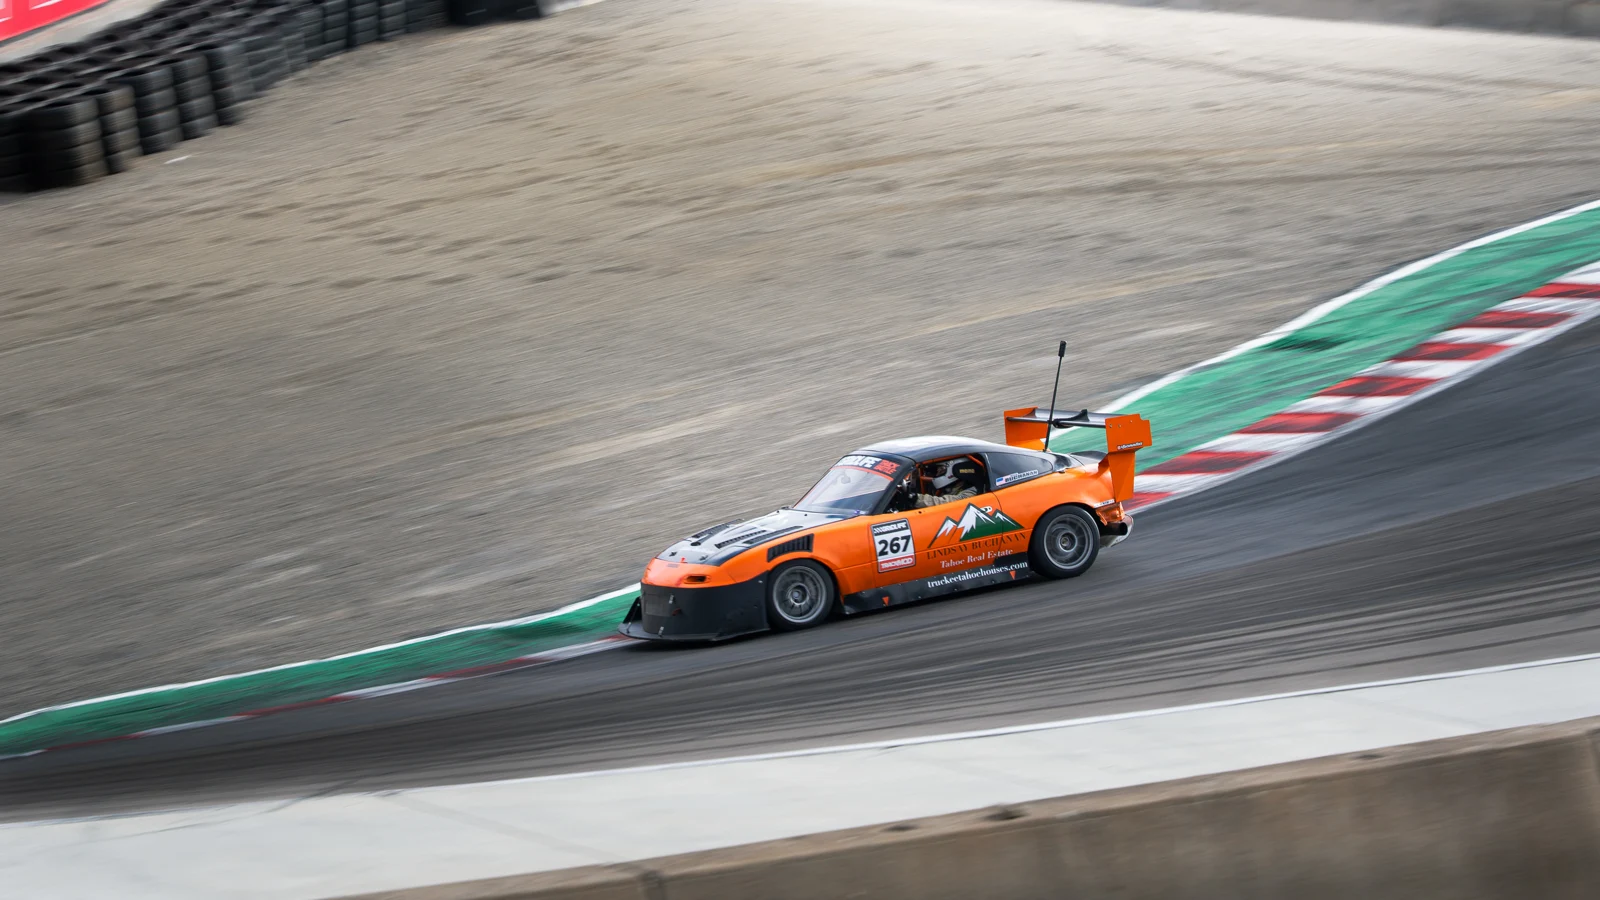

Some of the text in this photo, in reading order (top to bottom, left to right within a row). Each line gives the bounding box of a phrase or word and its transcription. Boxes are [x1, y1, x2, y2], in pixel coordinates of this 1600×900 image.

[878, 535, 911, 556] 267
[927, 533, 1027, 560] LINDSAY BUCHANAN
[940, 548, 1013, 569] Tahoe Real Estate
[927, 561, 1028, 588] truckeetahoehouses.com
